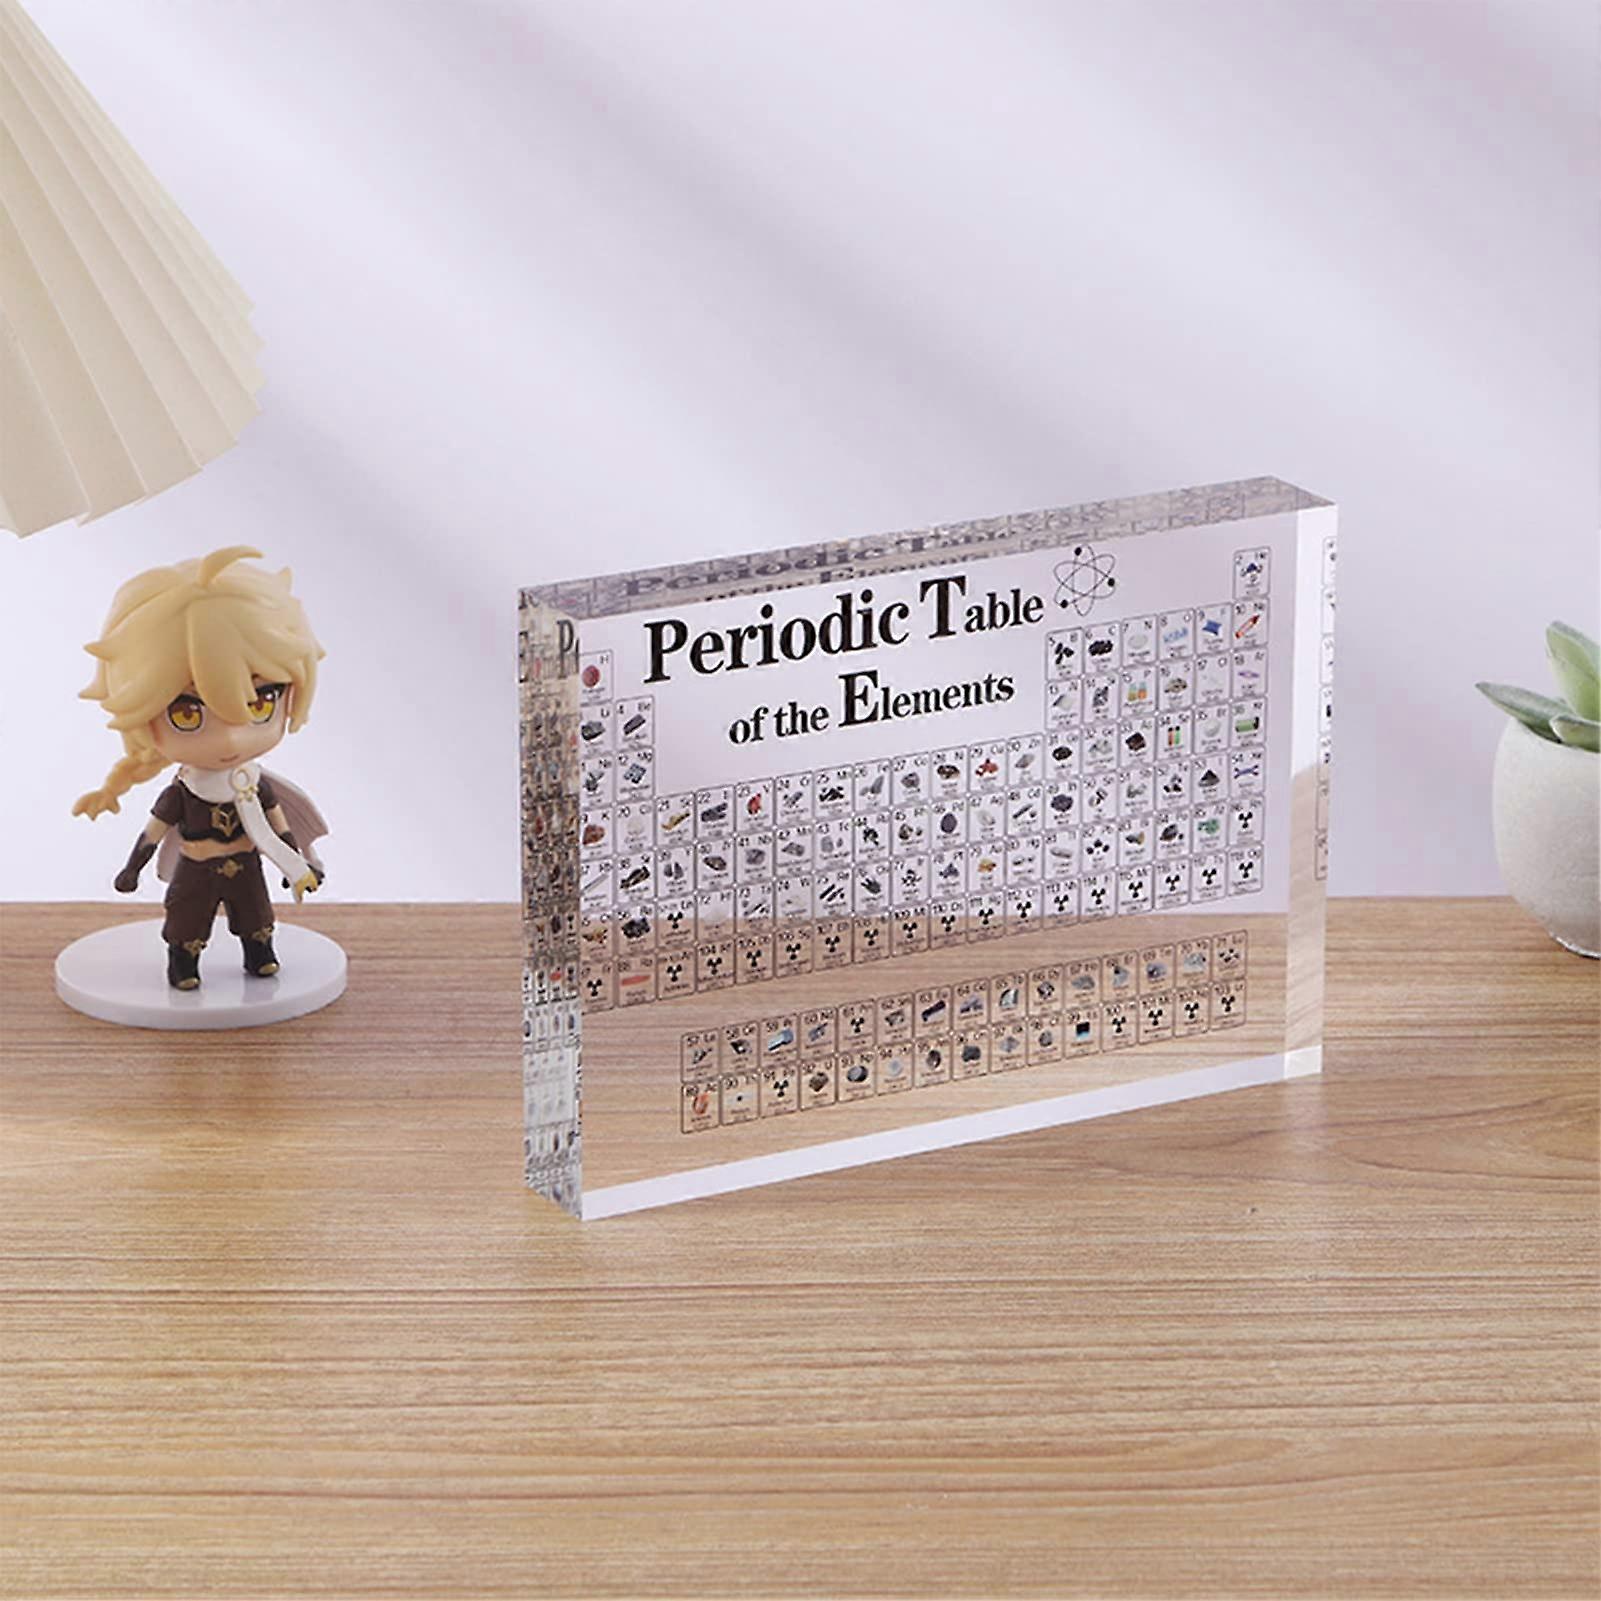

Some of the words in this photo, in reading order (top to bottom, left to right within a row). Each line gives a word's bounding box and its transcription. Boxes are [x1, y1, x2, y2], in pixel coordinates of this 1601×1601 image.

[643, 588, 911, 684] Periodic
[919, 575, 1044, 639] Table
[729, 706, 769, 744] of
[773, 702, 830, 738] the
[838, 670, 1015, 728] Elements
